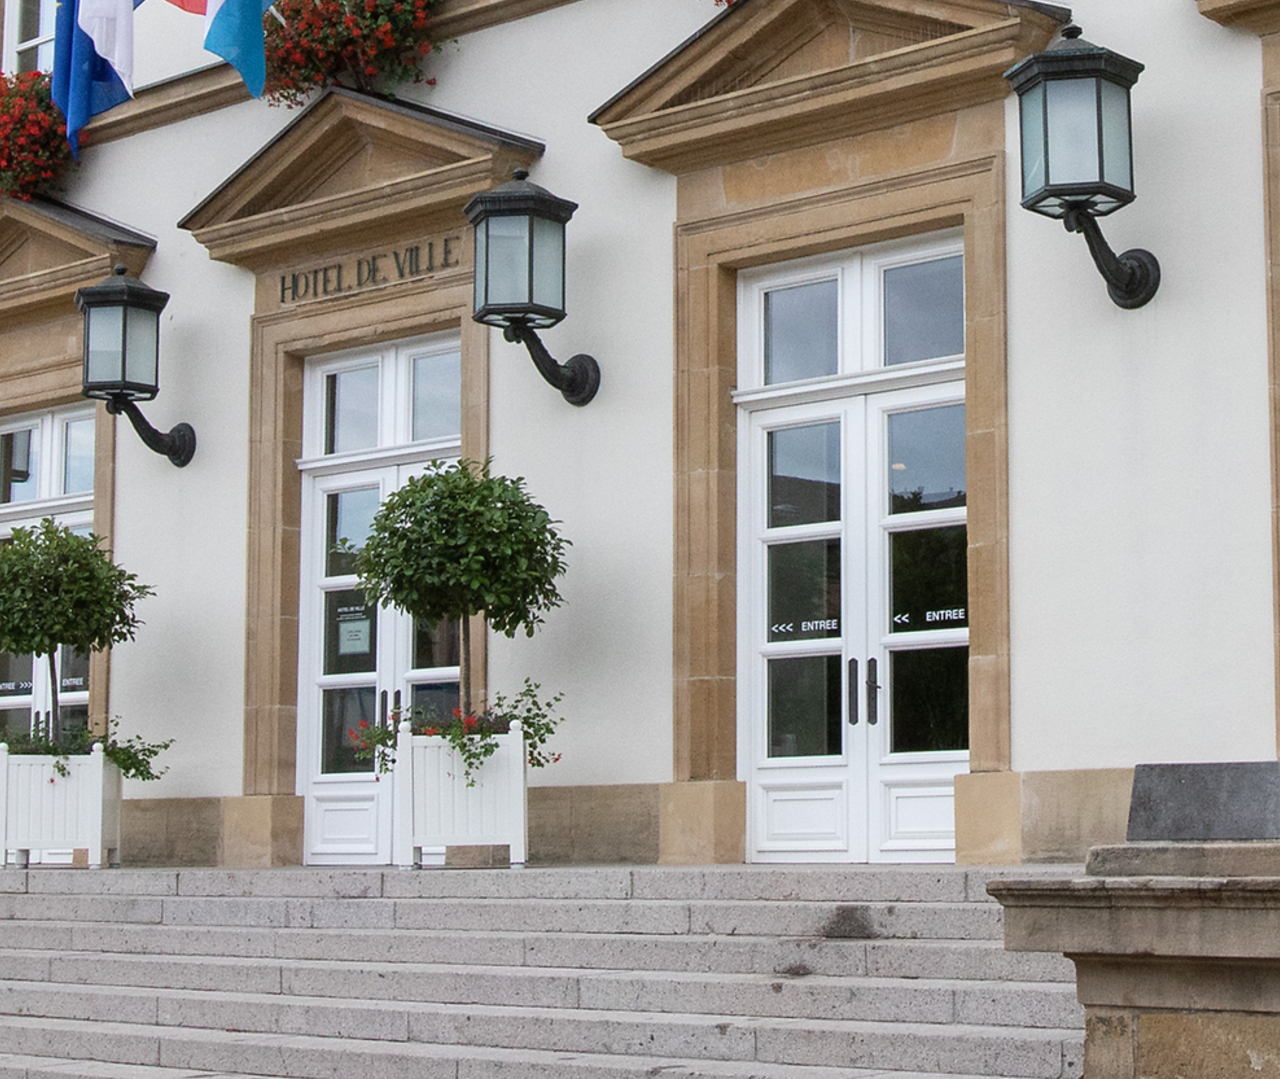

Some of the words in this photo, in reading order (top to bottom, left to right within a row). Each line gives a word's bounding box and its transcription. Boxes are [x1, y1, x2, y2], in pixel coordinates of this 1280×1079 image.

[280, 263, 352, 304] HOTEL
[356, 253, 388, 288] DE
[393, 235, 461, 279] VILLE
[926, 608, 966, 622] ENTREE
[801, 619, 839, 632] ENTREE
